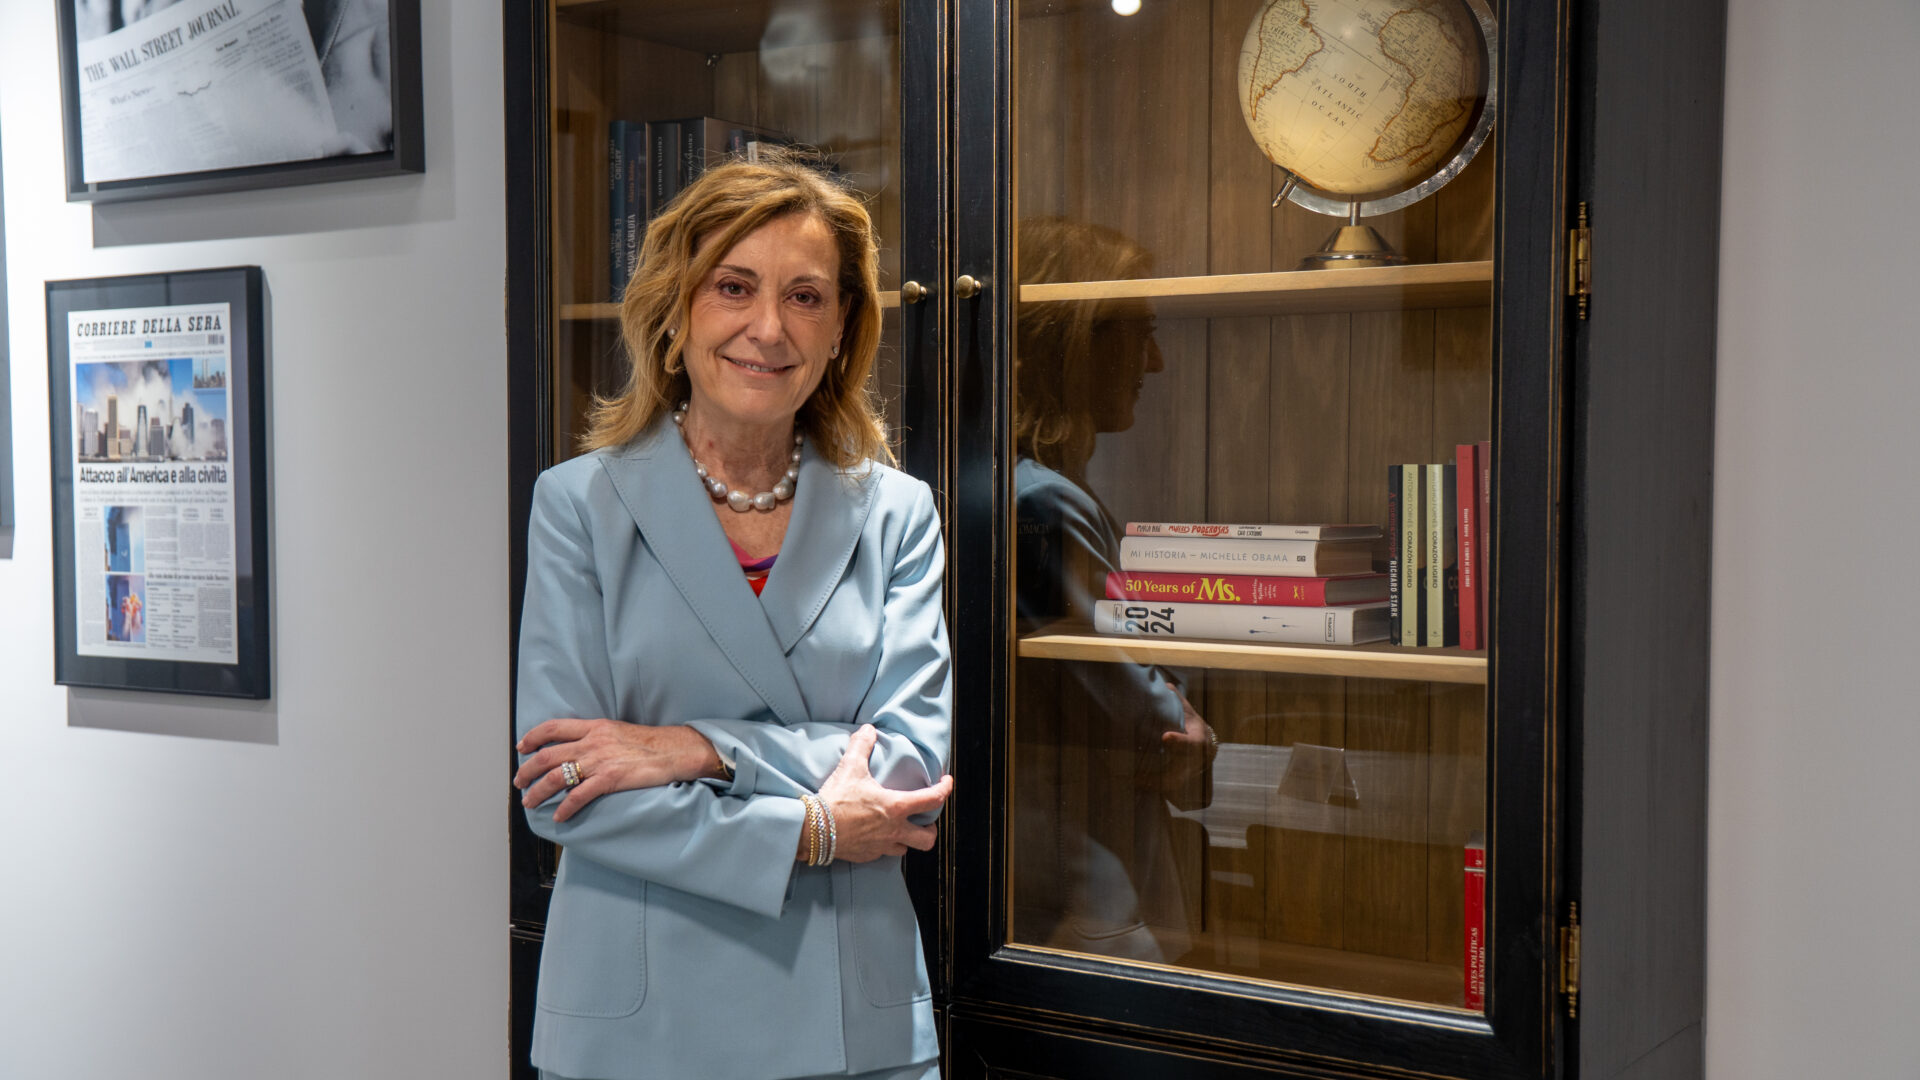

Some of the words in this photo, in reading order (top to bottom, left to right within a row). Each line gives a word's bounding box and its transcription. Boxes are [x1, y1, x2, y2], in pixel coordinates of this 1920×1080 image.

[84, 61, 108, 83] THE
[109, 48, 141, 73] WALL
[140, 27, 184, 61] STREET
[1332, 73, 1367, 98] SOUTH
[1311, 100, 1346, 127] OCEAN
[1315, 85, 1362, 120] ATLANTIC
[627, 214, 636, 248] CARLOTA
[77, 320, 136, 337] CORRIERE
[142, 317, 182, 334] DELLA
[188, 315, 222, 332] SERA
[80, 466, 115, 483] Attacco
[171, 471, 176, 483] e
[179, 466, 196, 483] alla
[198, 464, 227, 483] civiltà
[1191, 525, 1229, 537] PODEROSAS
[1130, 550, 1141, 559] MI
[1144, 550, 1187, 560] HISTORIA
[1200, 551, 1247, 561] MICHELLE
[1251, 552, 1288, 563] OBAMA
[1390, 560, 1398, 592] RICHARD
[1125, 580, 1142, 591] 50
[1143, 580, 1178, 594] Years
[1182, 580, 1197, 594] of
[1195, 577, 1241, 602] Ms.
[1390, 594, 1399, 617] STARK
[1125, 607, 1149, 633] 20
[1150, 607, 1175, 634] 24
[1470, 927, 1478, 968] POLÍTICAS
[1470, 968, 1478, 995] LEYES
